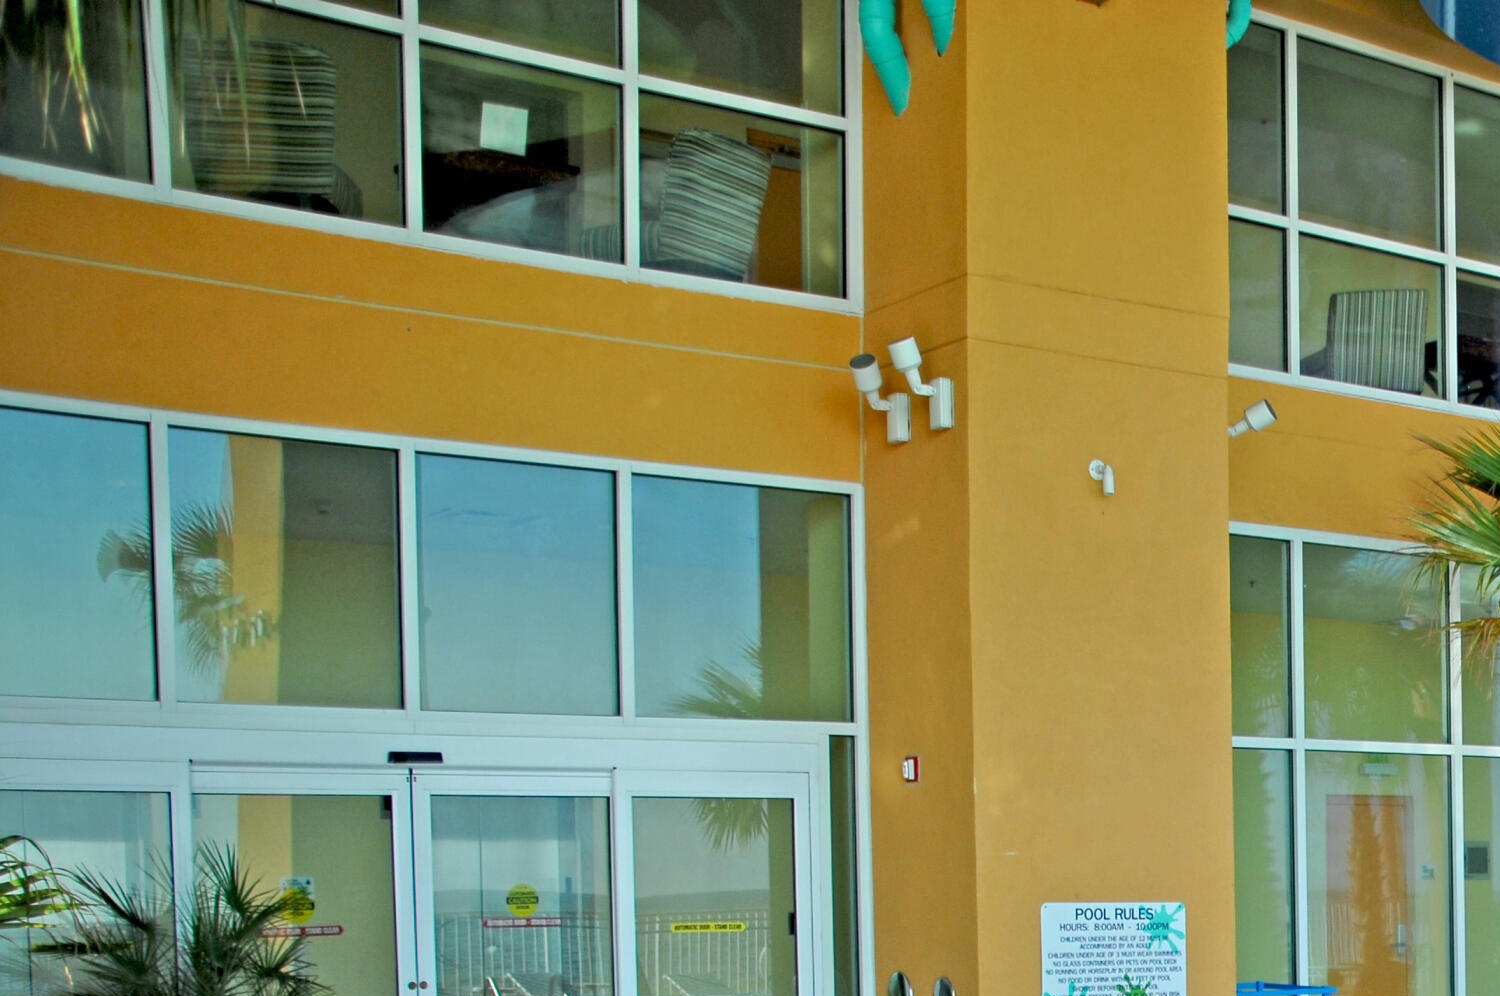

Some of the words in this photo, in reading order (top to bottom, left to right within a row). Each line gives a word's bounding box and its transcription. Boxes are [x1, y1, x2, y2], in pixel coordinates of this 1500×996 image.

[1075, 908, 1110, 920] POOL
[1114, 908, 1154, 920] RULES
[1094, 922, 1124, 931] 8:00AM
[1136, 922, 1169, 930] 10:00PM
